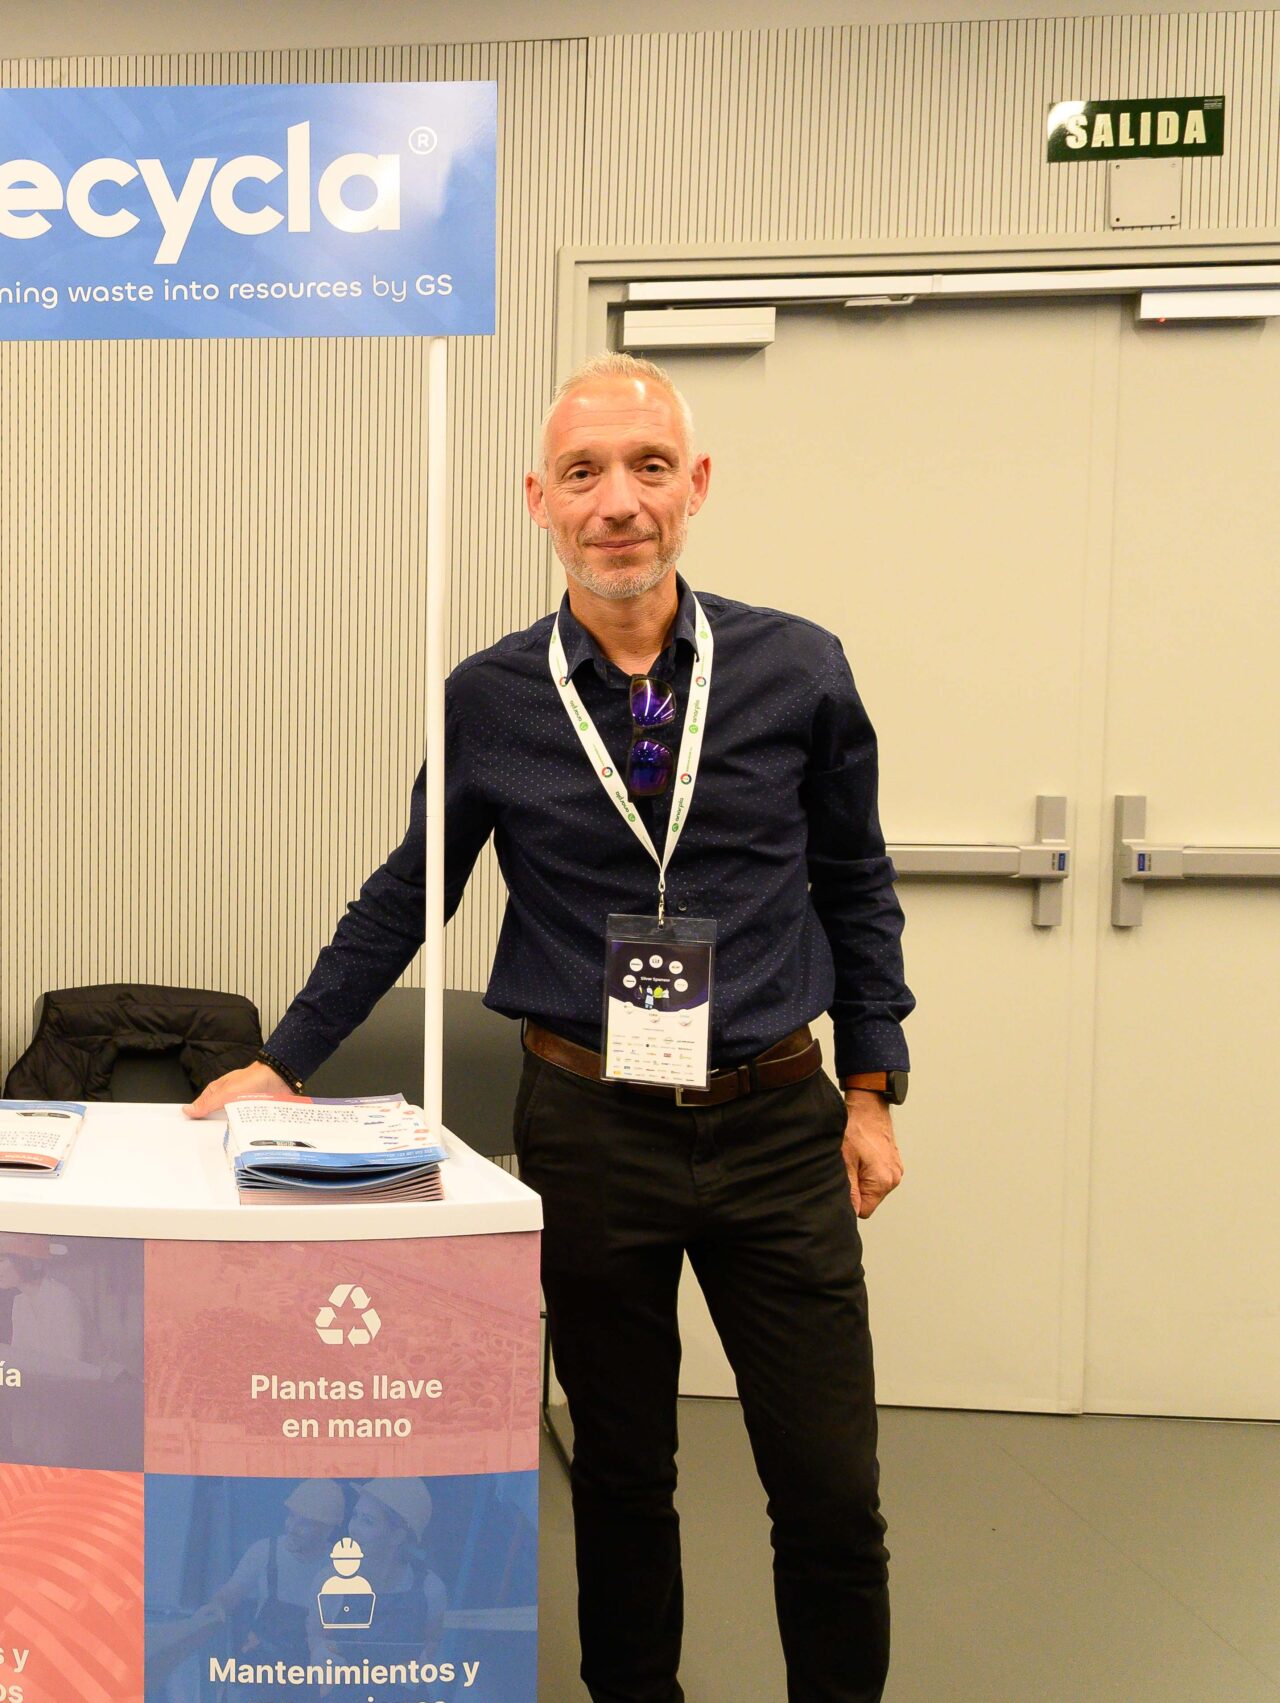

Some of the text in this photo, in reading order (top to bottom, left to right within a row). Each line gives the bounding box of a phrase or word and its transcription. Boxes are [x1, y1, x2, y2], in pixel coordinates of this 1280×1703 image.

[1065, 109, 1207, 149] SALIDA
[67, 282, 155, 303] waste
[163, 280, 221, 301] into
[228, 278, 364, 300] resources
[371, 274, 408, 303] by
[414, 274, 454, 297] GS
[250, 1374, 444, 1401] Plantas llave
[282, 1417, 412, 1438] en mano
[12, 1647, 31, 1674] y
[208, 1657, 480, 1687] Mantenimientos y
